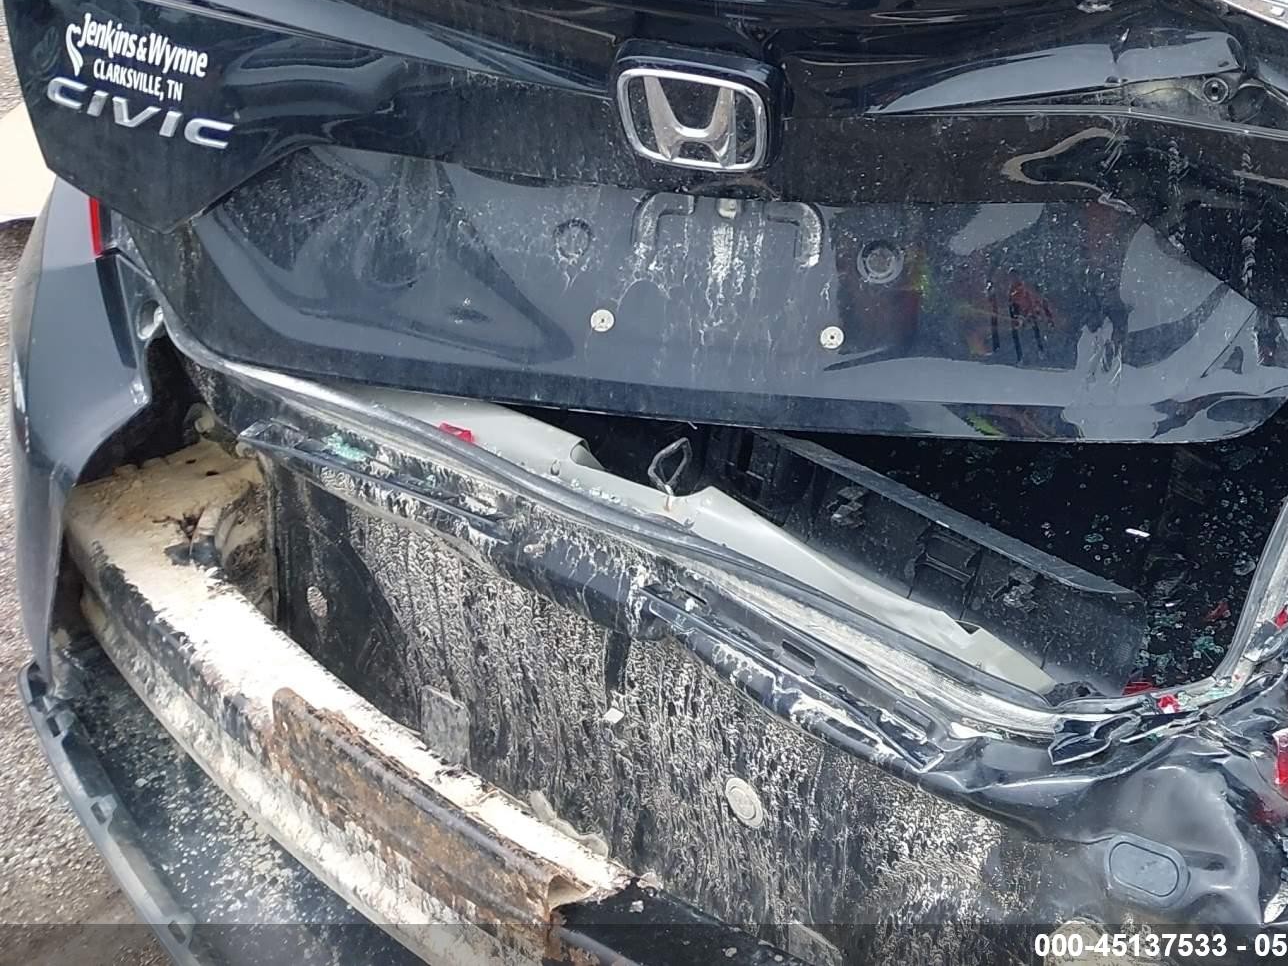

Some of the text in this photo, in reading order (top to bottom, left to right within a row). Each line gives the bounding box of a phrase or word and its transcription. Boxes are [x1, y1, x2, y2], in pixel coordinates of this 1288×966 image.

[93, 58, 183, 101] CLARKSVILLE, TN
[47, 76, 236, 150] CIVIC
